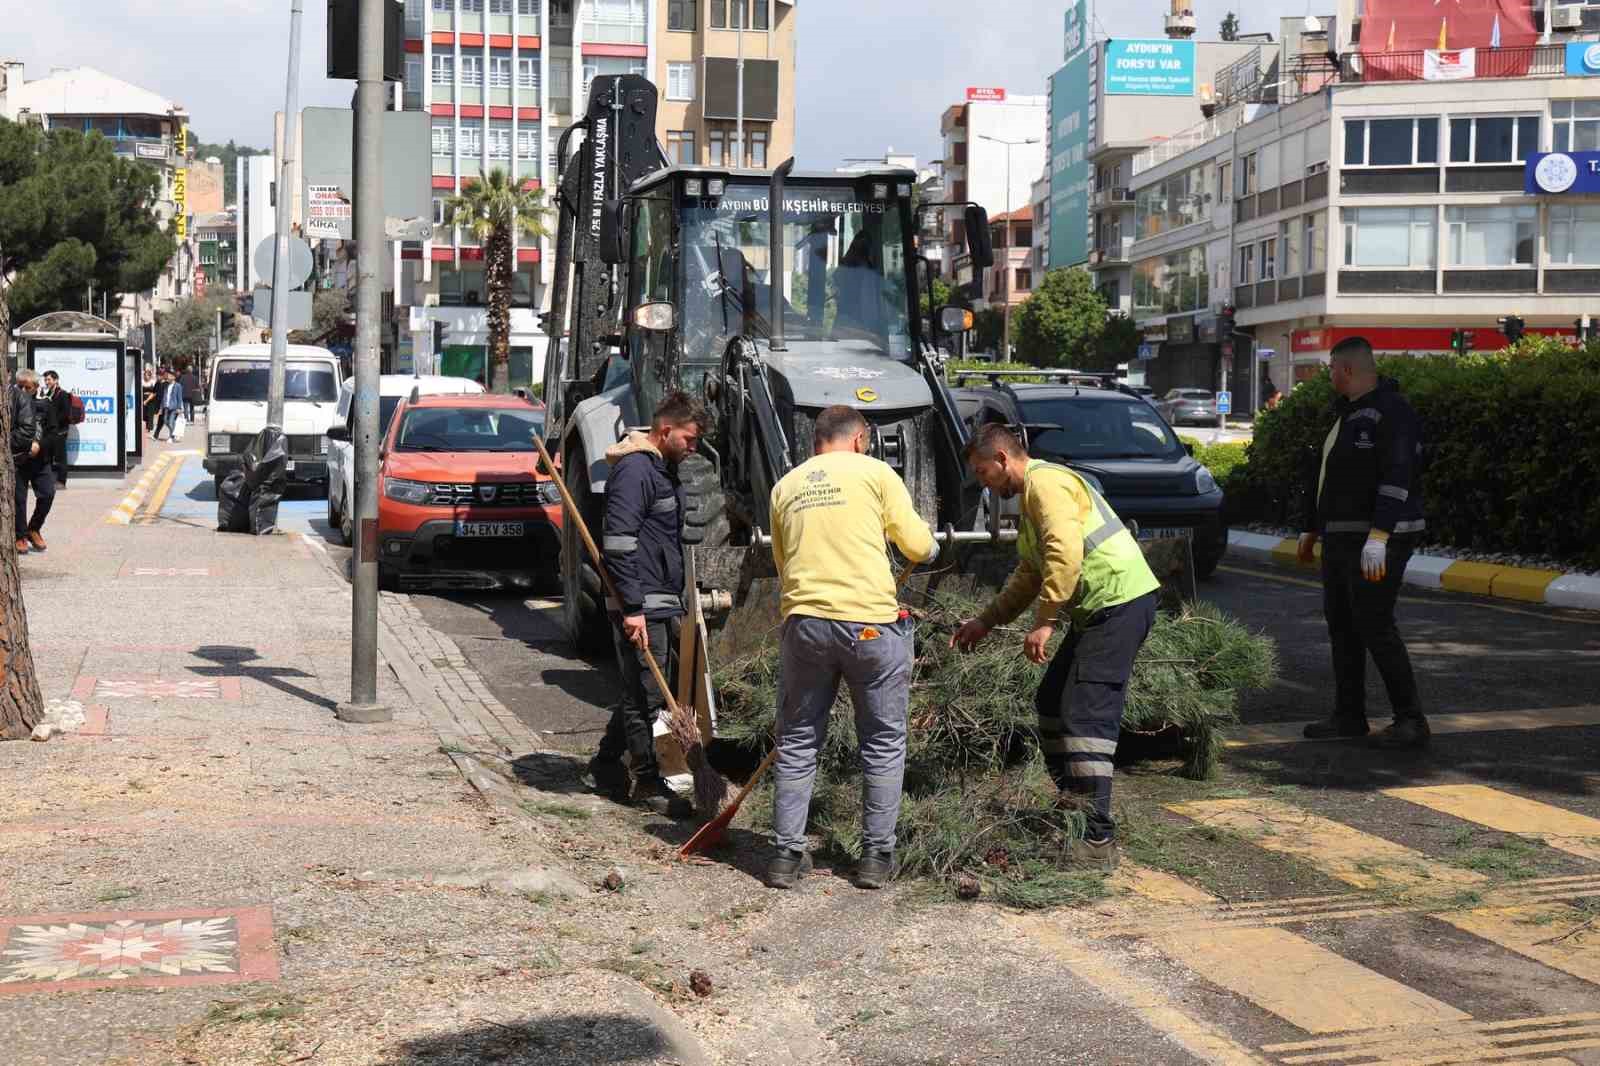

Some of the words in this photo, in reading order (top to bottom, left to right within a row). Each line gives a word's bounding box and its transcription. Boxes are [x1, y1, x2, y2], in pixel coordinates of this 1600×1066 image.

[1159, 60, 1182, 70] VAR
[595, 117, 609, 170] YAKLAŞMA
[593, 171, 605, 201] FAZLA
[721, 199, 752, 212] AYDIN
[753, 197, 830, 215] BÜKŞEHİR
[463, 524, 476, 536] 34
[478, 523, 500, 536] EKV
